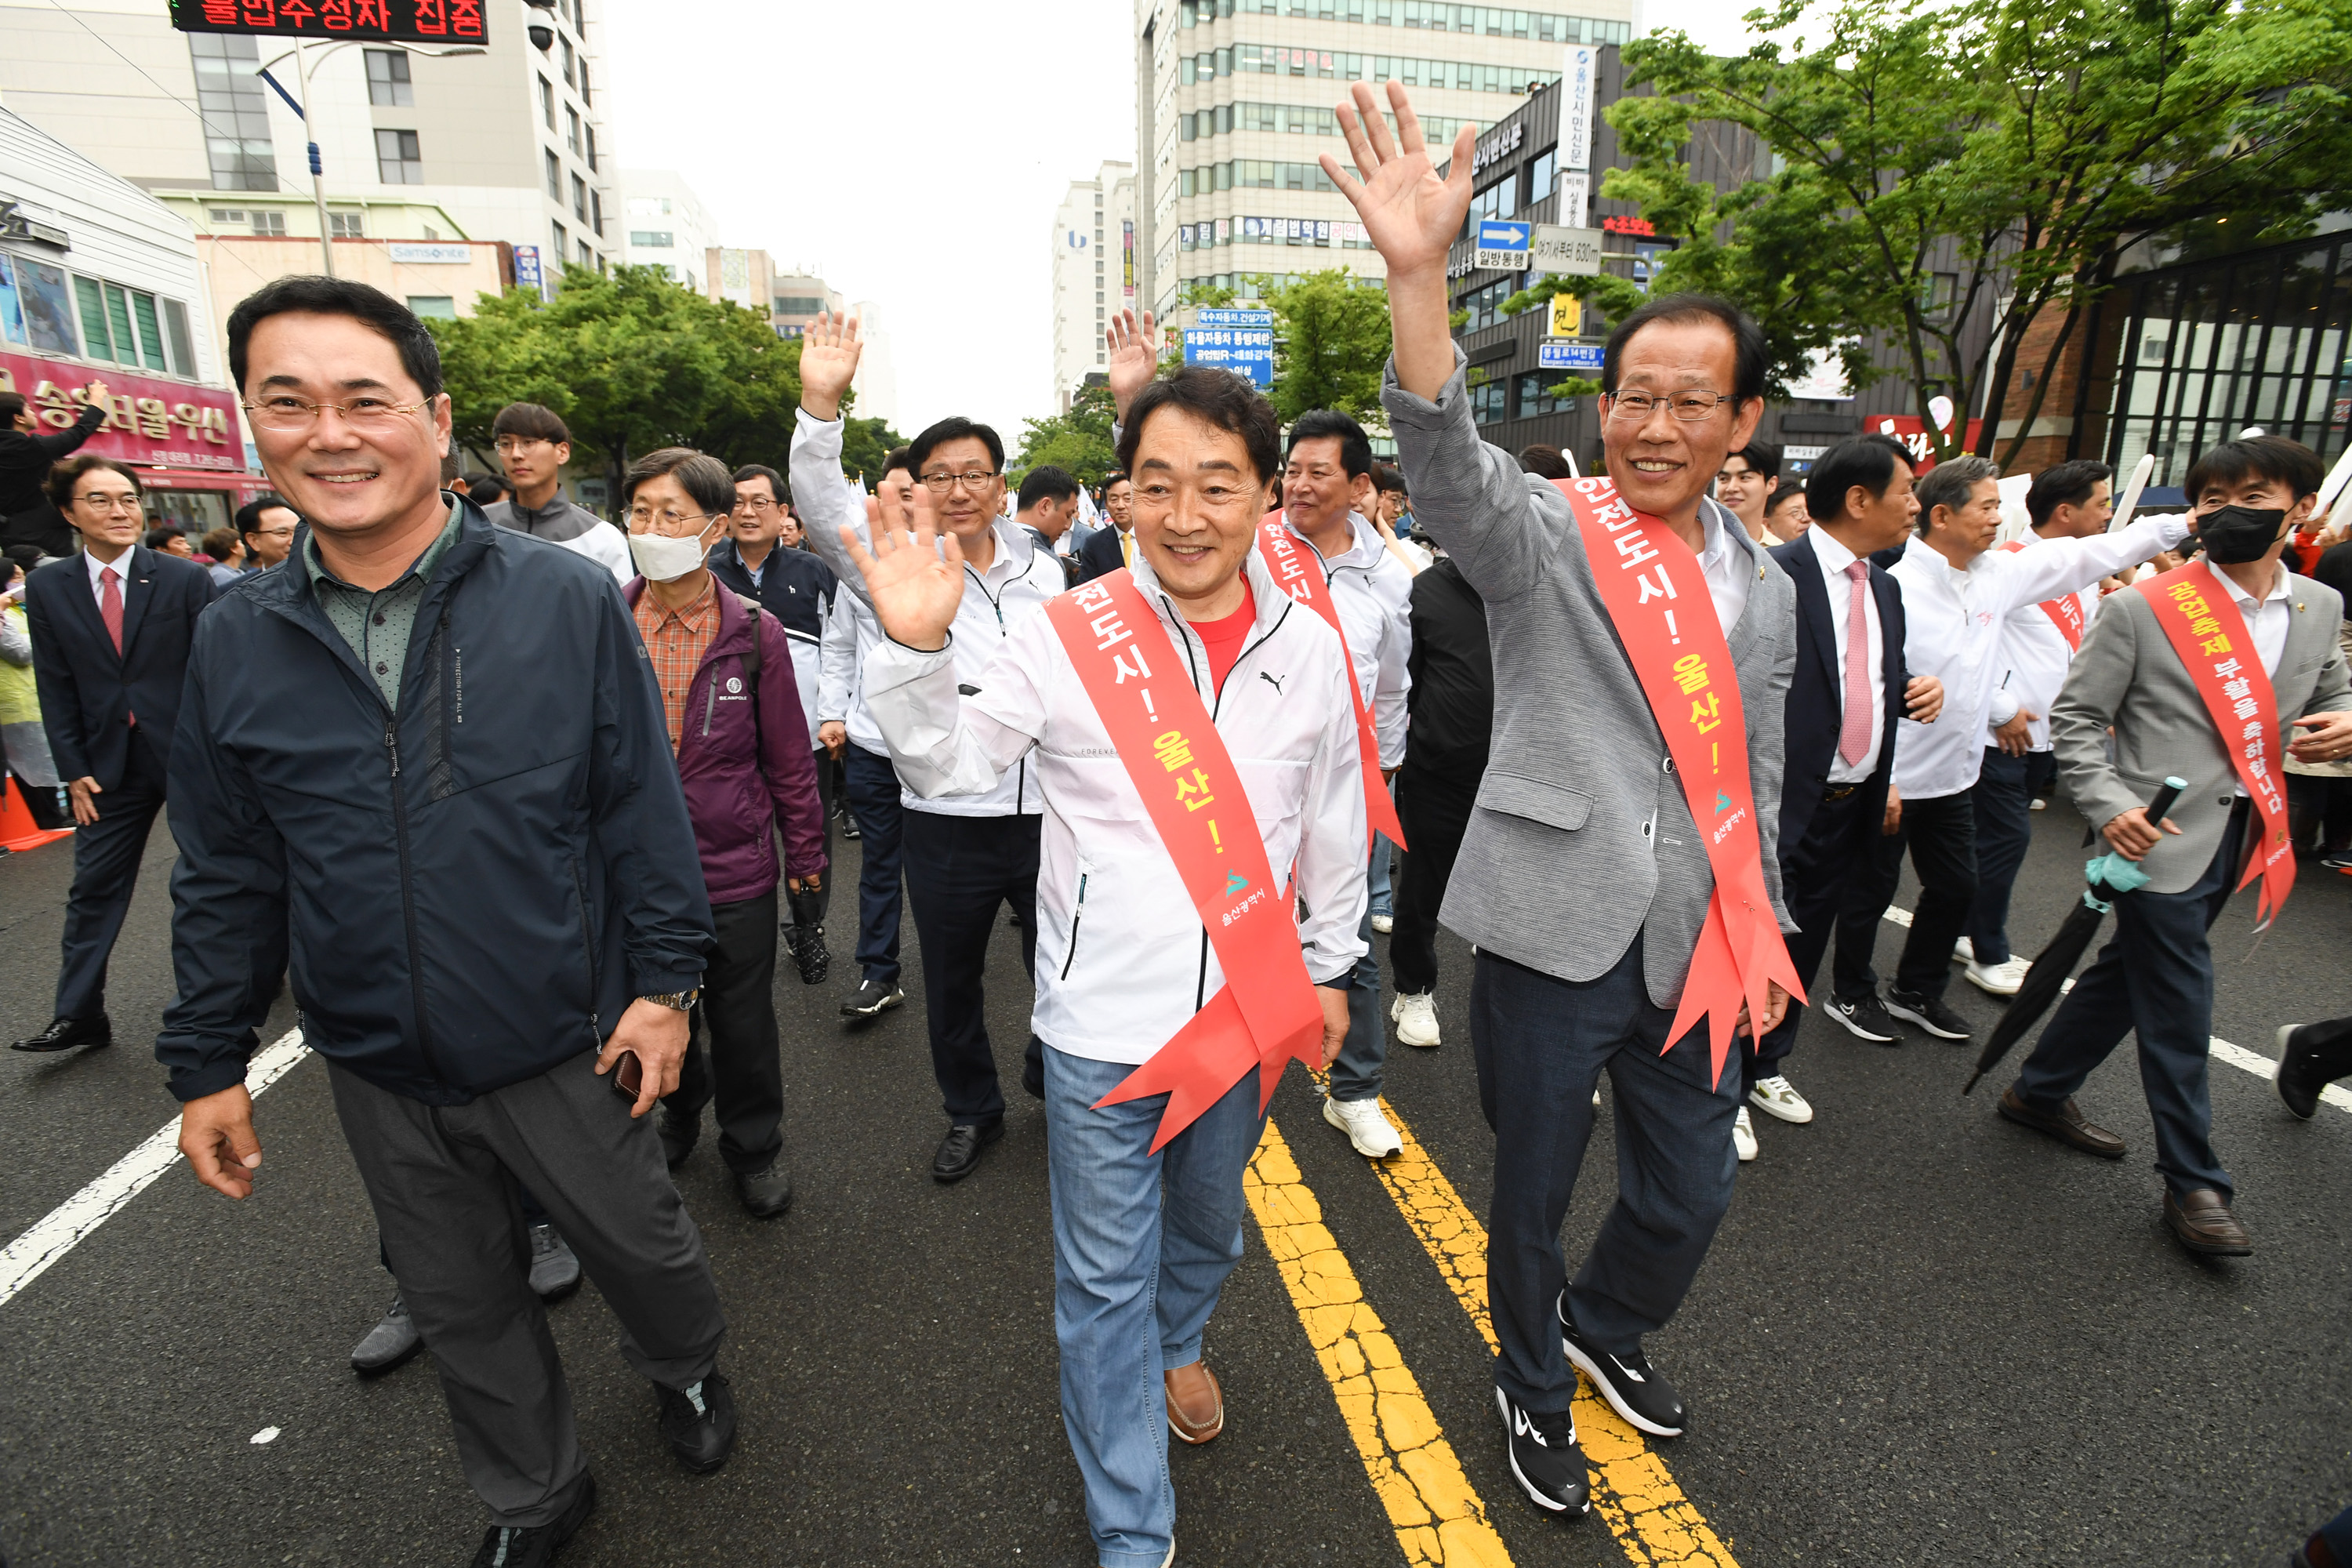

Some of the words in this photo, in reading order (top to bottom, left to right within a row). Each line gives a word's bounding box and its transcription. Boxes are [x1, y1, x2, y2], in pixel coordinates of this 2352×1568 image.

[1571, 67, 1587, 164] 울산시민신문
[1260, 218, 1329, 239] 계림법학원
[394, 247, 465, 259] Samsonite
[1480, 251, 1524, 267] 일방통행
[1537, 239, 1573, 262] 여기서부터
[1575, 240, 1599, 263] 630m
[1187, 331, 1231, 345] 화물자동차
[1234, 331, 1270, 345] 통행제한
[1070, 579, 1159, 723] 전도시!
[2167, 580, 2233, 657] 공업축제
[2213, 657, 2259, 720] 부활을
[2242, 720, 2283, 815] 축하합니다
[1713, 808, 1746, 845] 울산광역시
[1221, 887, 1266, 927] 울산광역시
